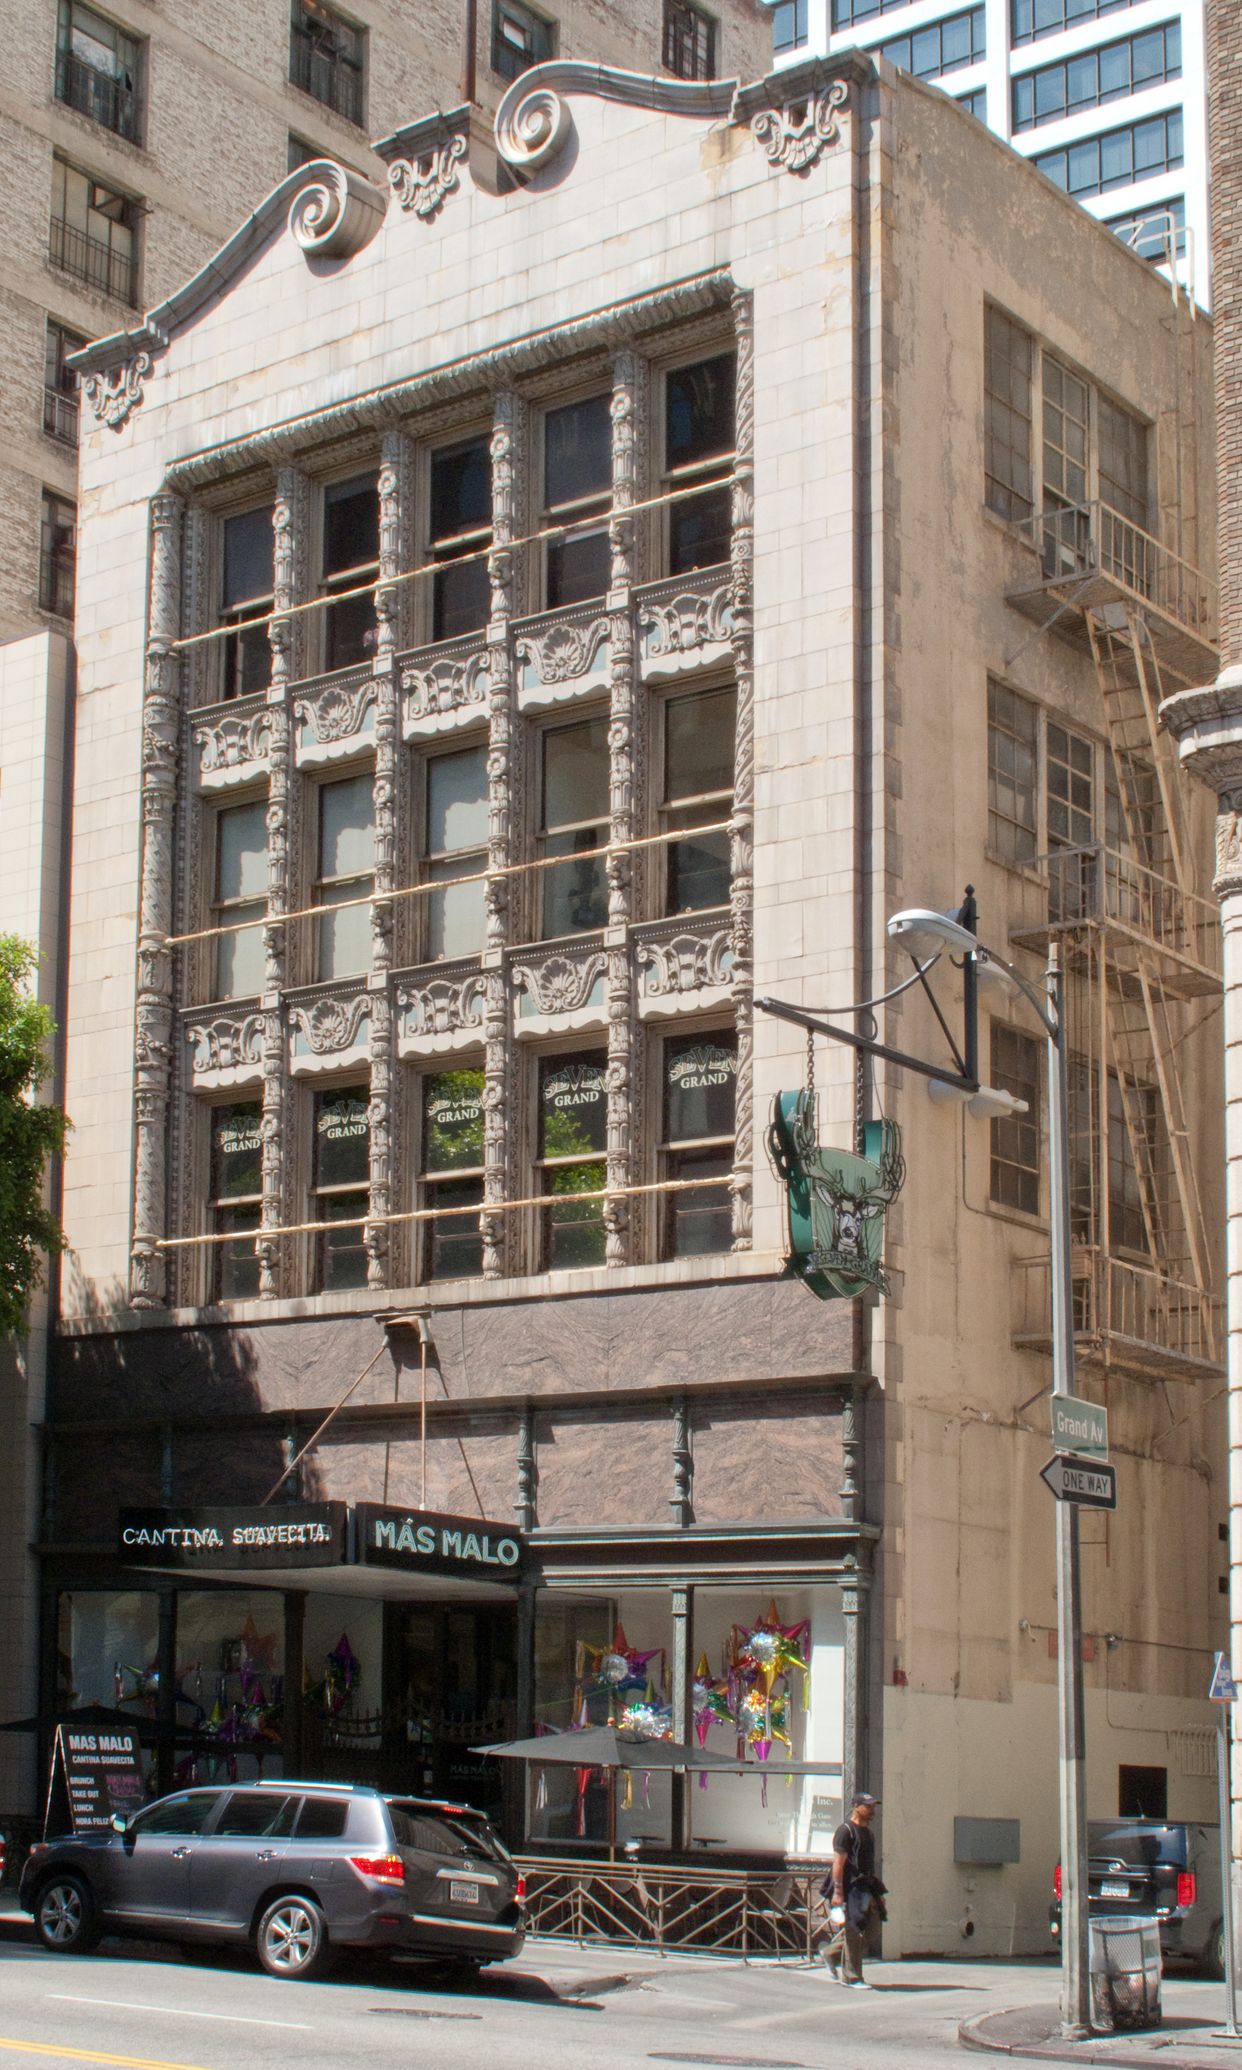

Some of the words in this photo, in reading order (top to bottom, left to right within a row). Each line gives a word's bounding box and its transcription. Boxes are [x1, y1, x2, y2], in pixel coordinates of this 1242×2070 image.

[668, 1045, 738, 1084] SEVEN
[680, 1072, 728, 1089] GRAND
[554, 1091, 599, 1107] GRAND
[437, 1108, 479, 1123] GRAND
[327, 1124, 367, 1139] GRAND
[223, 1138, 261, 1153] GRAND
[1057, 1411, 1088, 1439] Grand
[1090, 1421, 1103, 1443] Av
[1062, 1470, 1085, 1491] ONE
[1087, 1475, 1109, 1494] WAY
[442, 1530, 519, 1566] MALO
[69, 1735, 97, 1750] MAS
[99, 1736, 133, 1752] MALO
[72, 1755, 100, 1764] CANTINA
[72, 1790, 87, 1798] TAKE
[87, 1790, 99, 1798] OUT
[73, 1804, 94, 1812] LUNCH
